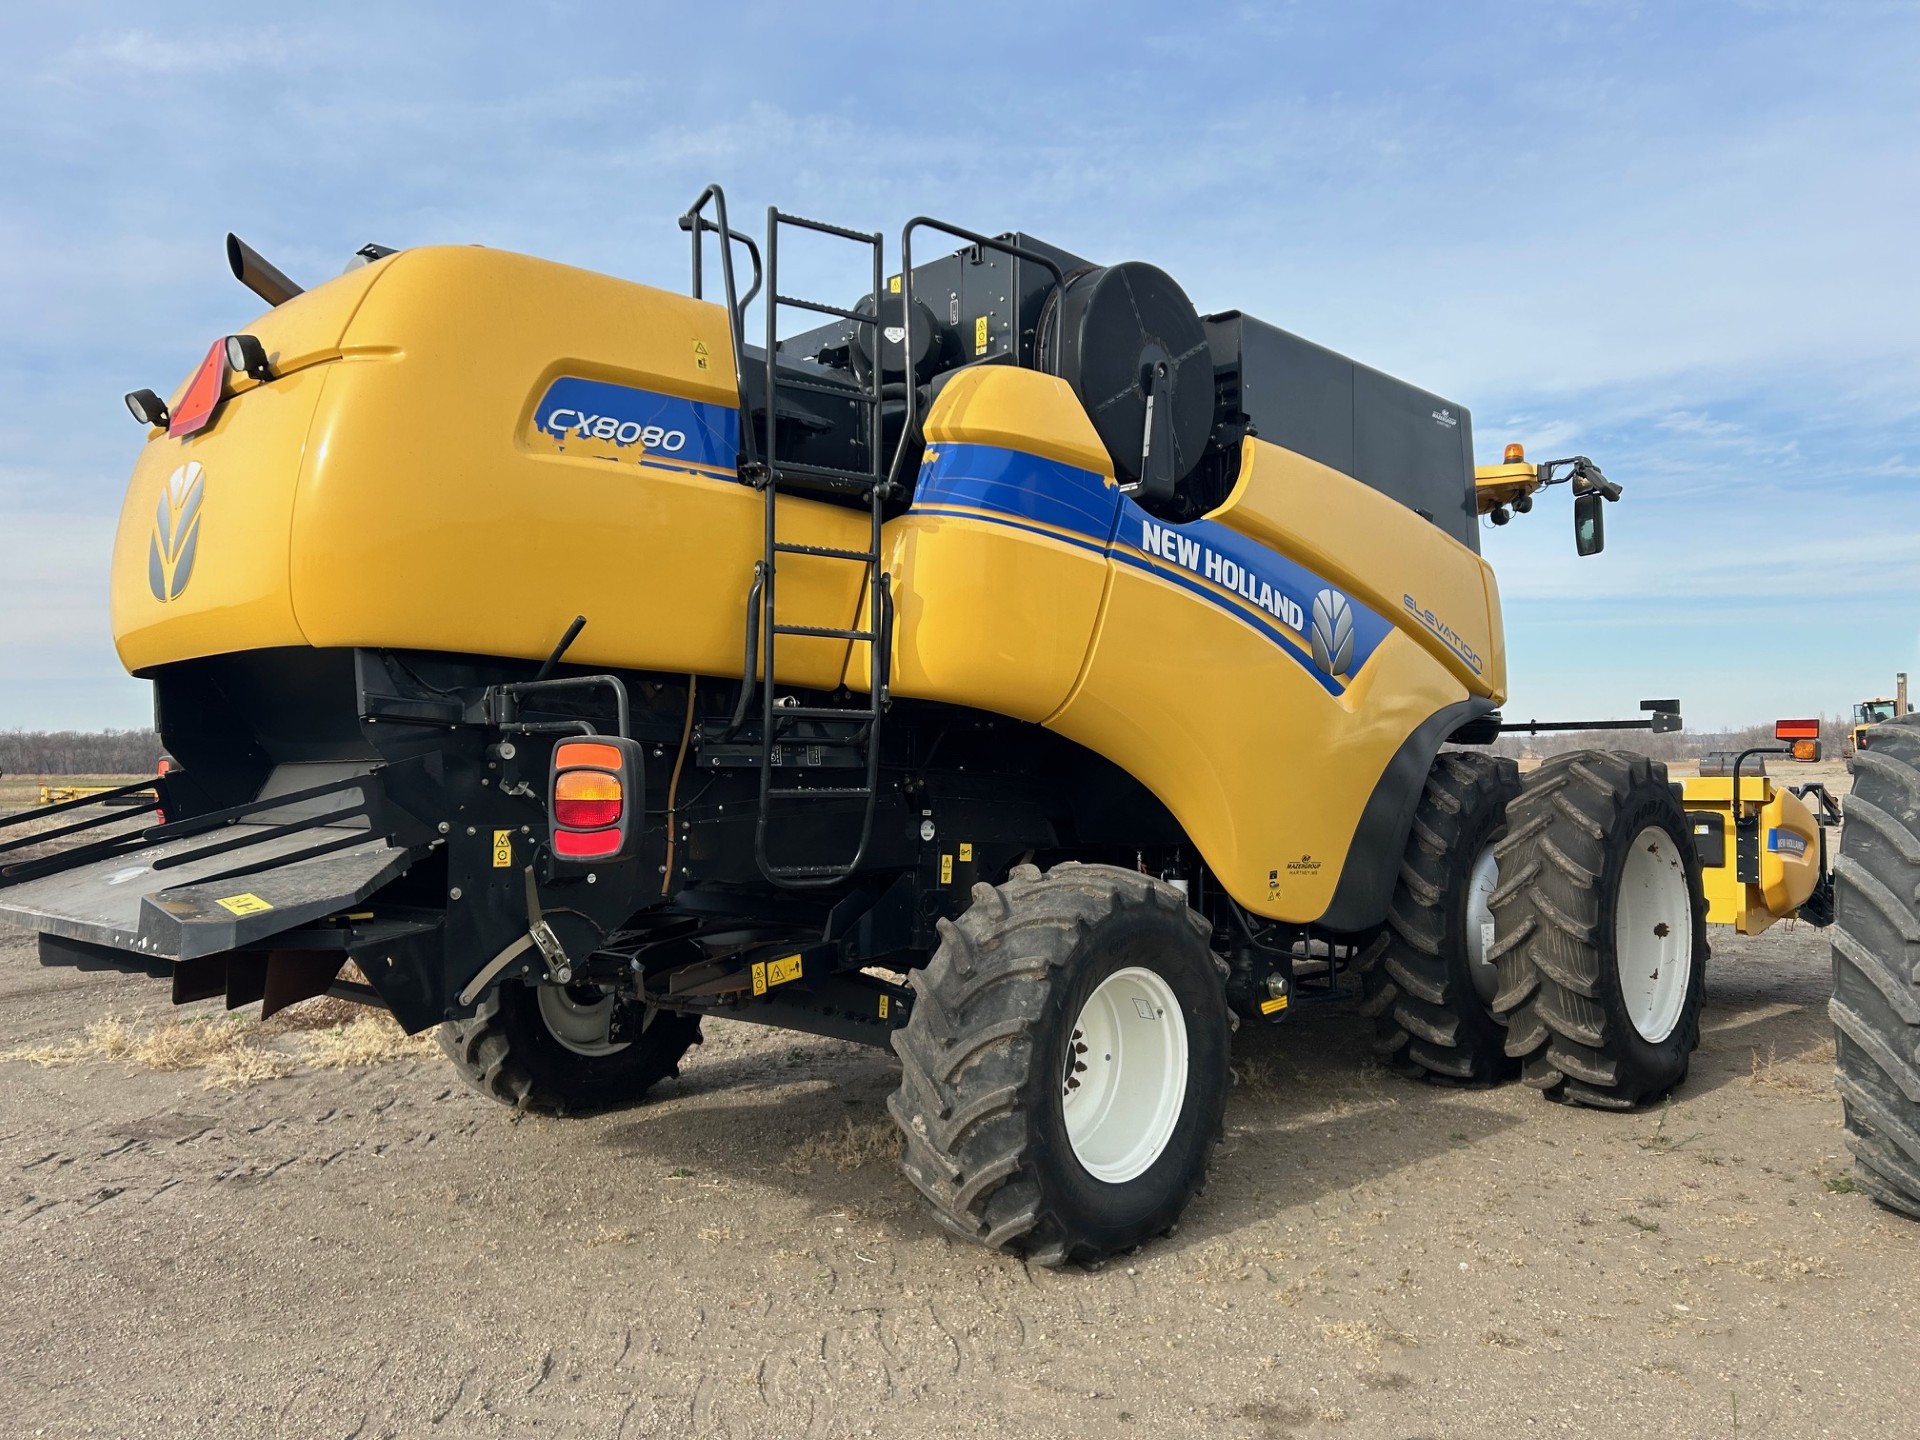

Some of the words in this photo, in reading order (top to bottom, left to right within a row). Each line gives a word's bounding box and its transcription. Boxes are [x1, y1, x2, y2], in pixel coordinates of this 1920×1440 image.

[547, 408, 686, 452] CX8080
[1141, 520, 1200, 572] NEW
[1204, 547, 1304, 632] HOLLAND
[1403, 593, 1484, 670] ELEVATION
[1777, 838, 1786, 848] NEW
[1786, 838, 1804, 851] HOLLAND
